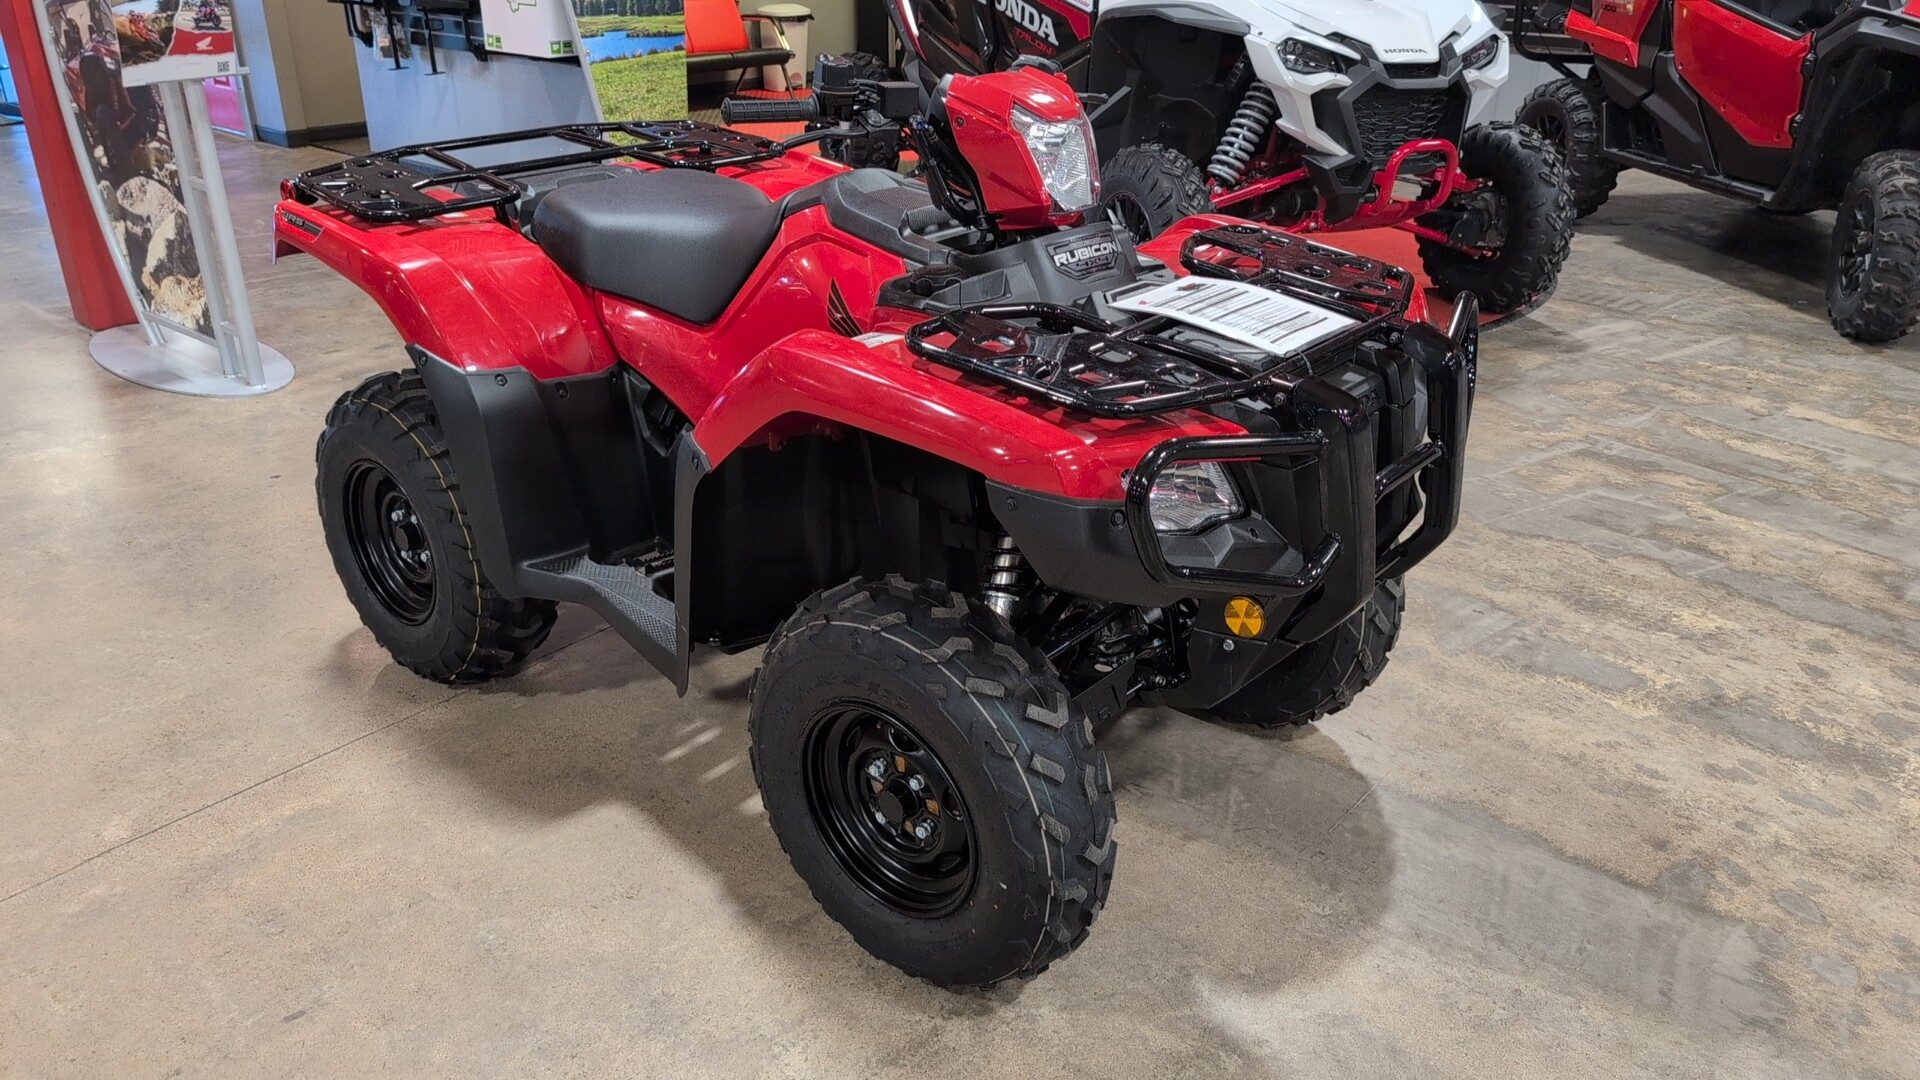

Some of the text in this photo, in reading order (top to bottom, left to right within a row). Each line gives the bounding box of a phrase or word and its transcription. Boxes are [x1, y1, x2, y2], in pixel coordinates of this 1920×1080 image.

[977, 0, 1059, 46] ONDA
[1014, 26, 1053, 55] TALON
[1053, 241, 1118, 267] RUBICON
